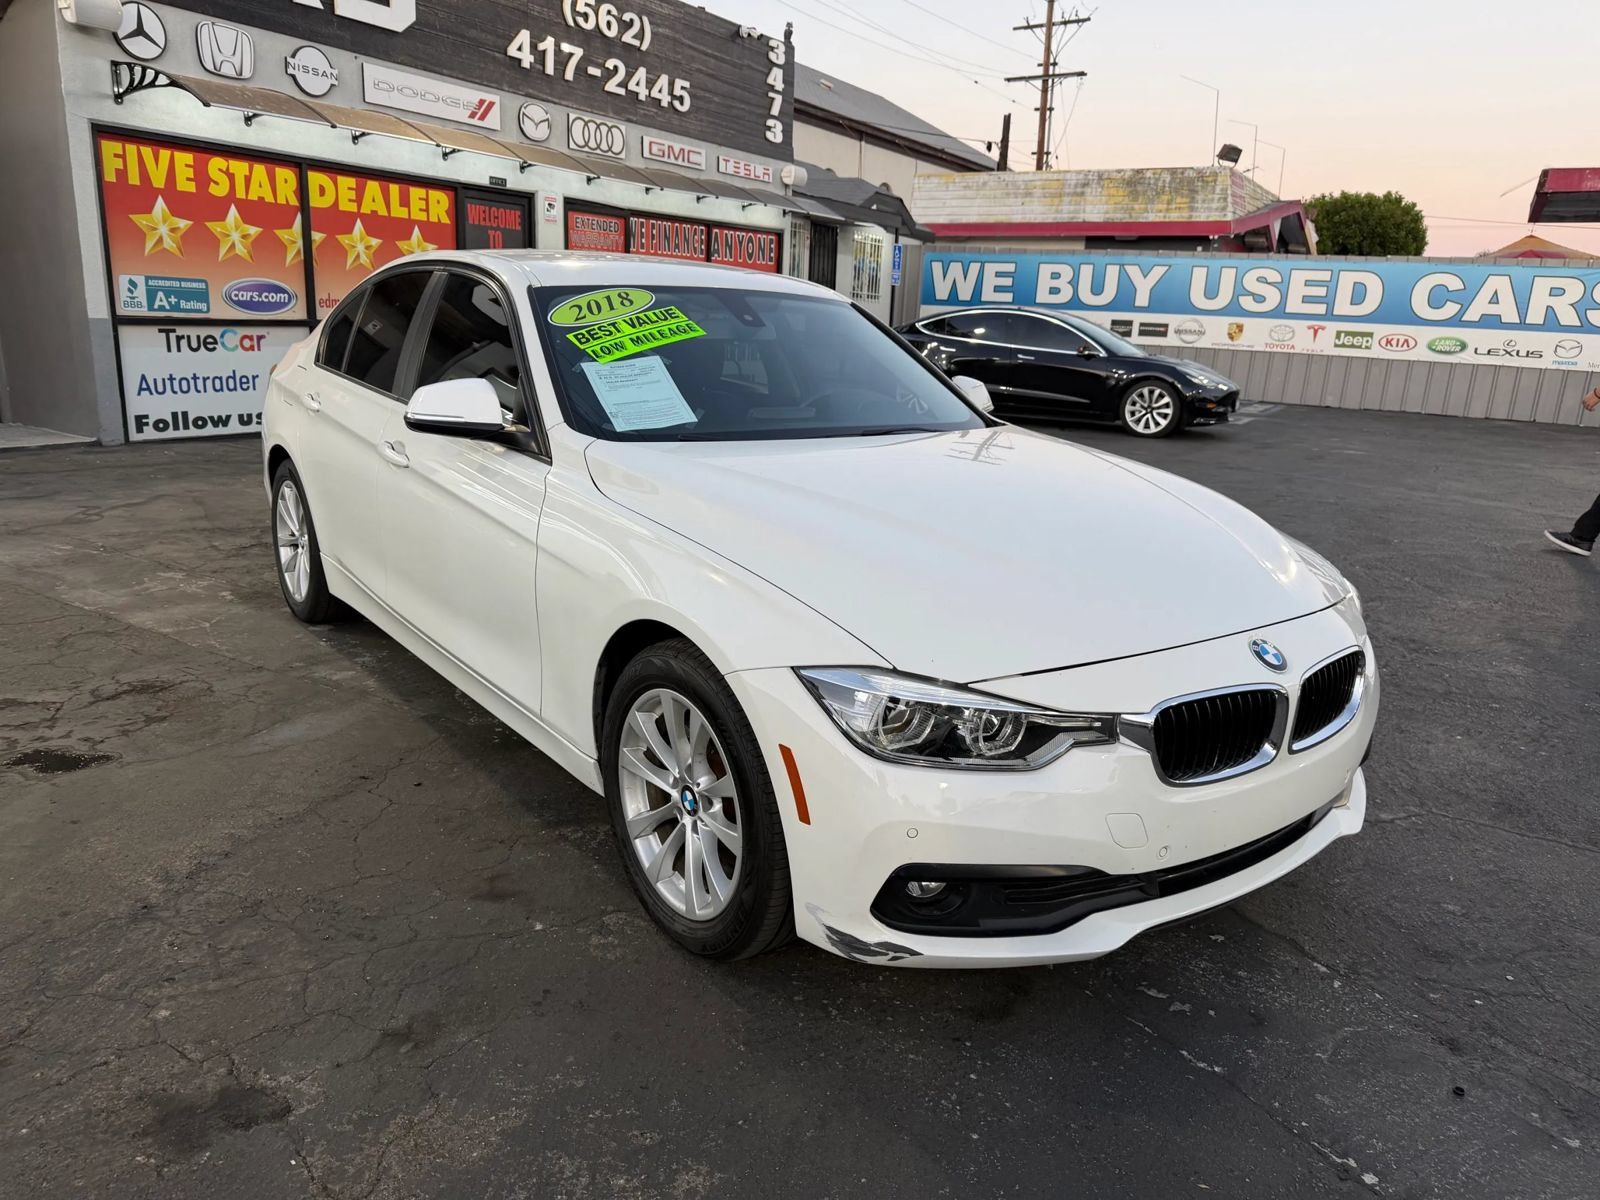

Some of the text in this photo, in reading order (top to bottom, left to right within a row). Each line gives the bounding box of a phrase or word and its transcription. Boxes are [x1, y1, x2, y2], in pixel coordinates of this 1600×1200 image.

[562, 0, 652, 52] (562)
[287, 61, 338, 81] NISSAN
[506, 28, 691, 112] 417-2445
[373, 79, 480, 111] DODGE
[648, 142, 703, 168] GMC
[722, 158, 772, 182] TESLA
[100, 140, 451, 225] FIVE STAR DEALER
[467, 203, 521, 230] WELCOME
[575, 216, 620, 233] EXTENDED
[487, 230, 502, 249] TO
[570, 231, 625, 250] WARRANTY
[649, 220, 706, 258] FINANCE
[711, 229, 775, 265] ANYONE
[148, 279, 206, 289] ACCREDITED BUSINESS
[930, 260, 1017, 304] WE
[1035, 262, 1170, 308] BUY
[1188, 265, 1385, 319] USED
[123, 300, 143, 309] BBB
[153, 290, 207, 311] A+ Rating
[231, 290, 289, 303] cars.com
[568, 290, 635, 322] 2018
[574, 307, 680, 346] BEST VALUE
[158, 328, 267, 353] TrueCar
[590, 322, 698, 360] LOW MILEAGE
[1264, 342, 1296, 351] TOYOTA
[1335, 333, 1372, 348] Jeep
[1385, 337, 1411, 348] KIA
[1474, 347, 1543, 359] LEXUS
[136, 369, 260, 397] Autotrader
[134, 411, 232, 434] Follow
